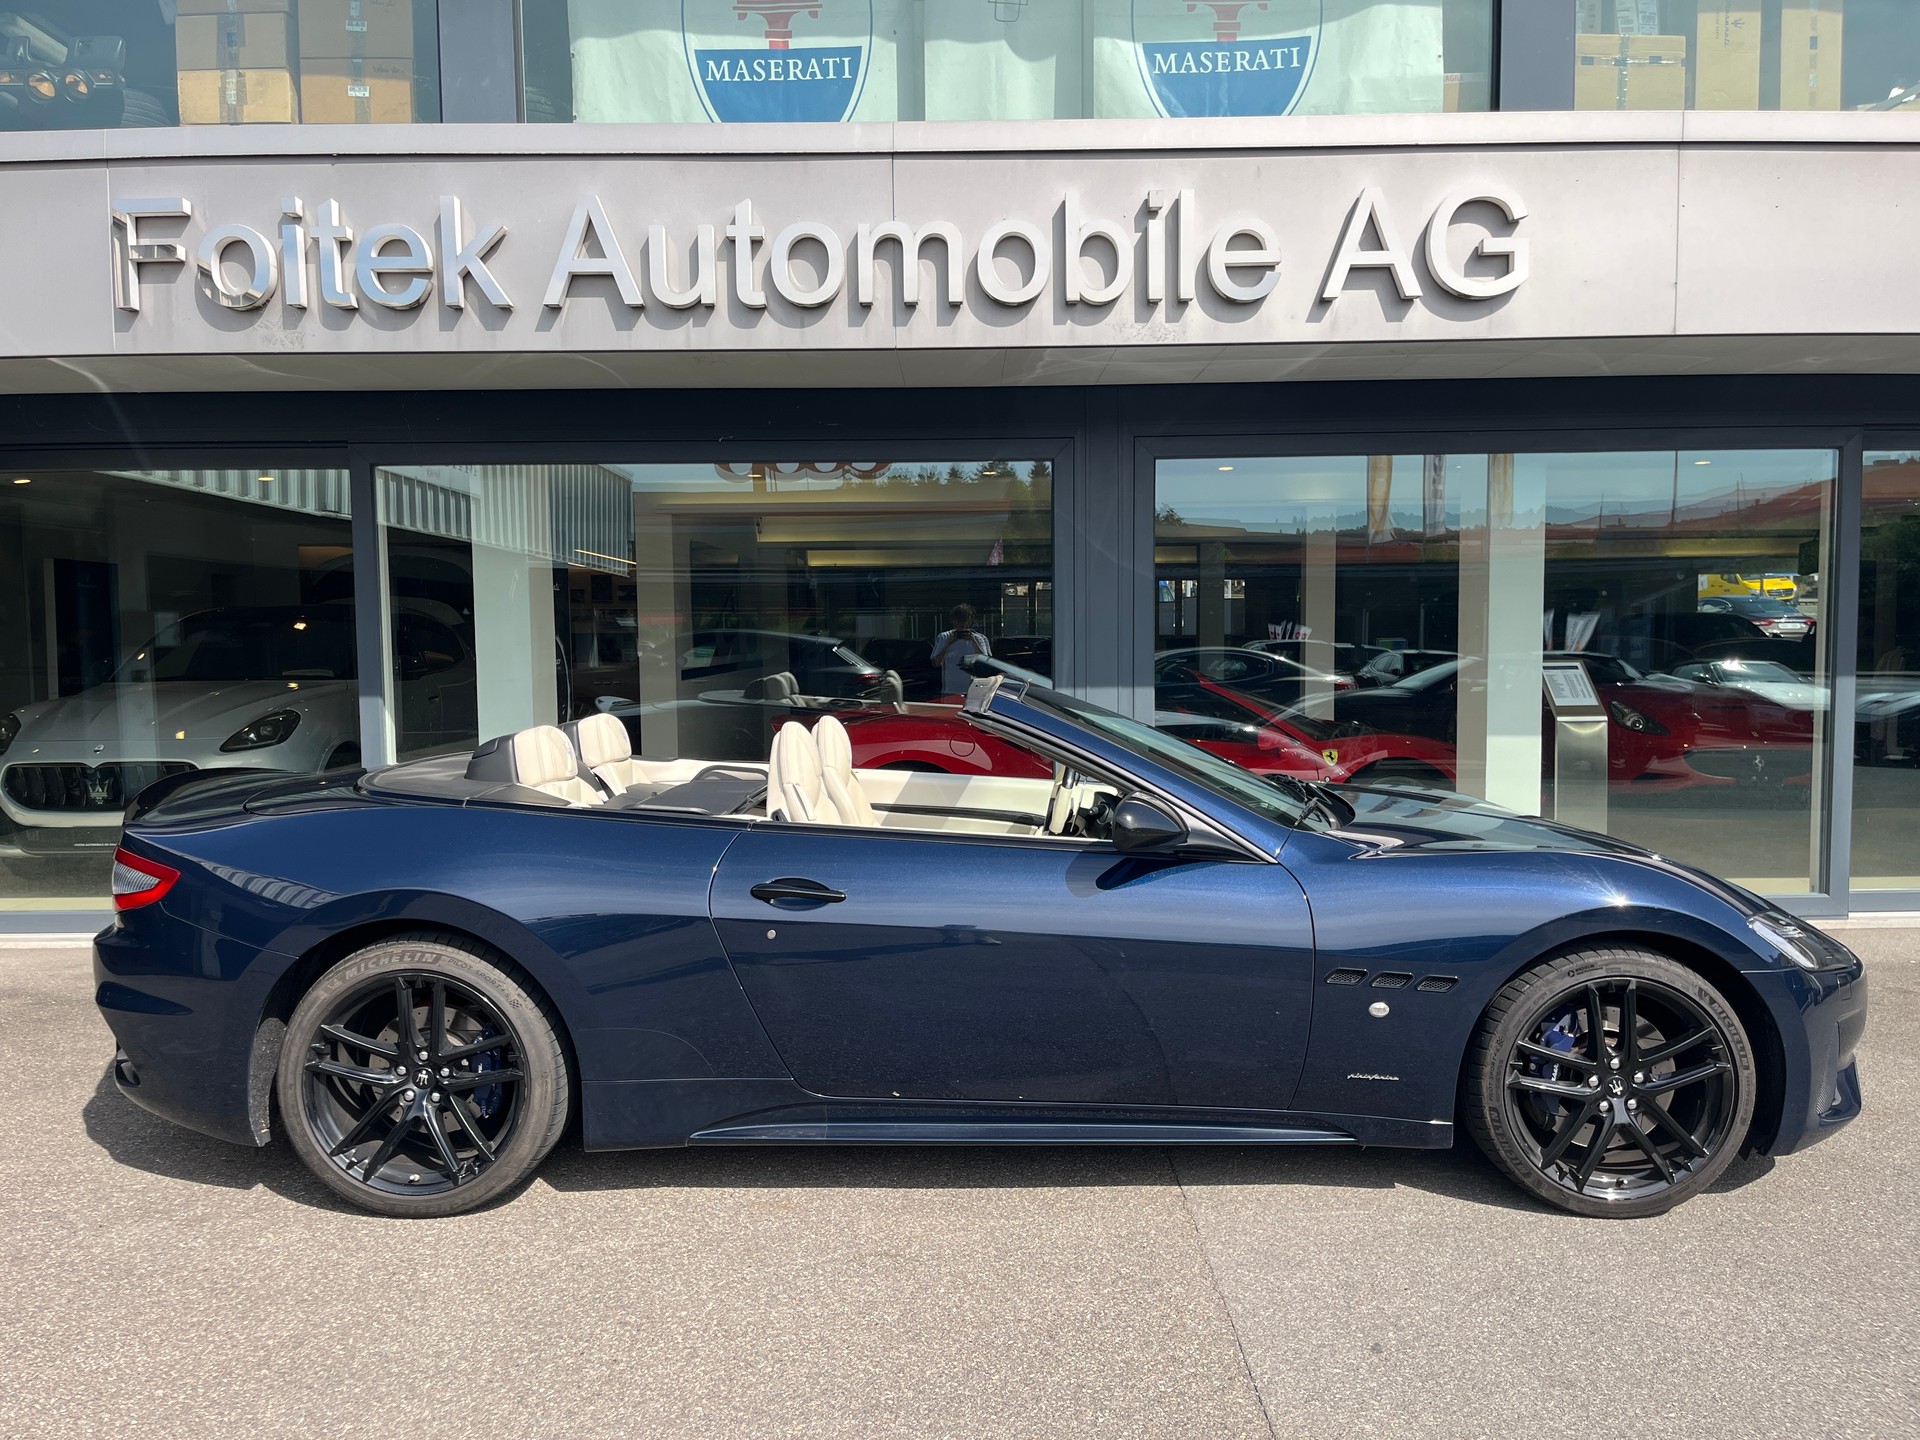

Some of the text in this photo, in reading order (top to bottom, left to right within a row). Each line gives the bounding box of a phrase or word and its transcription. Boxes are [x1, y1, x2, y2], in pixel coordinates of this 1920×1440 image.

[705, 57, 853, 82] MASERATI
[1152, 47, 1301, 74] MASERATI
[112, 186, 1530, 313] Foitek Automobile AG
[345, 952, 438, 981] MICHELIN
[447, 957, 474, 972] PILOT
[474, 969, 503, 990] SPORT
[1711, 1001, 1751, 1071] MICHELIN
